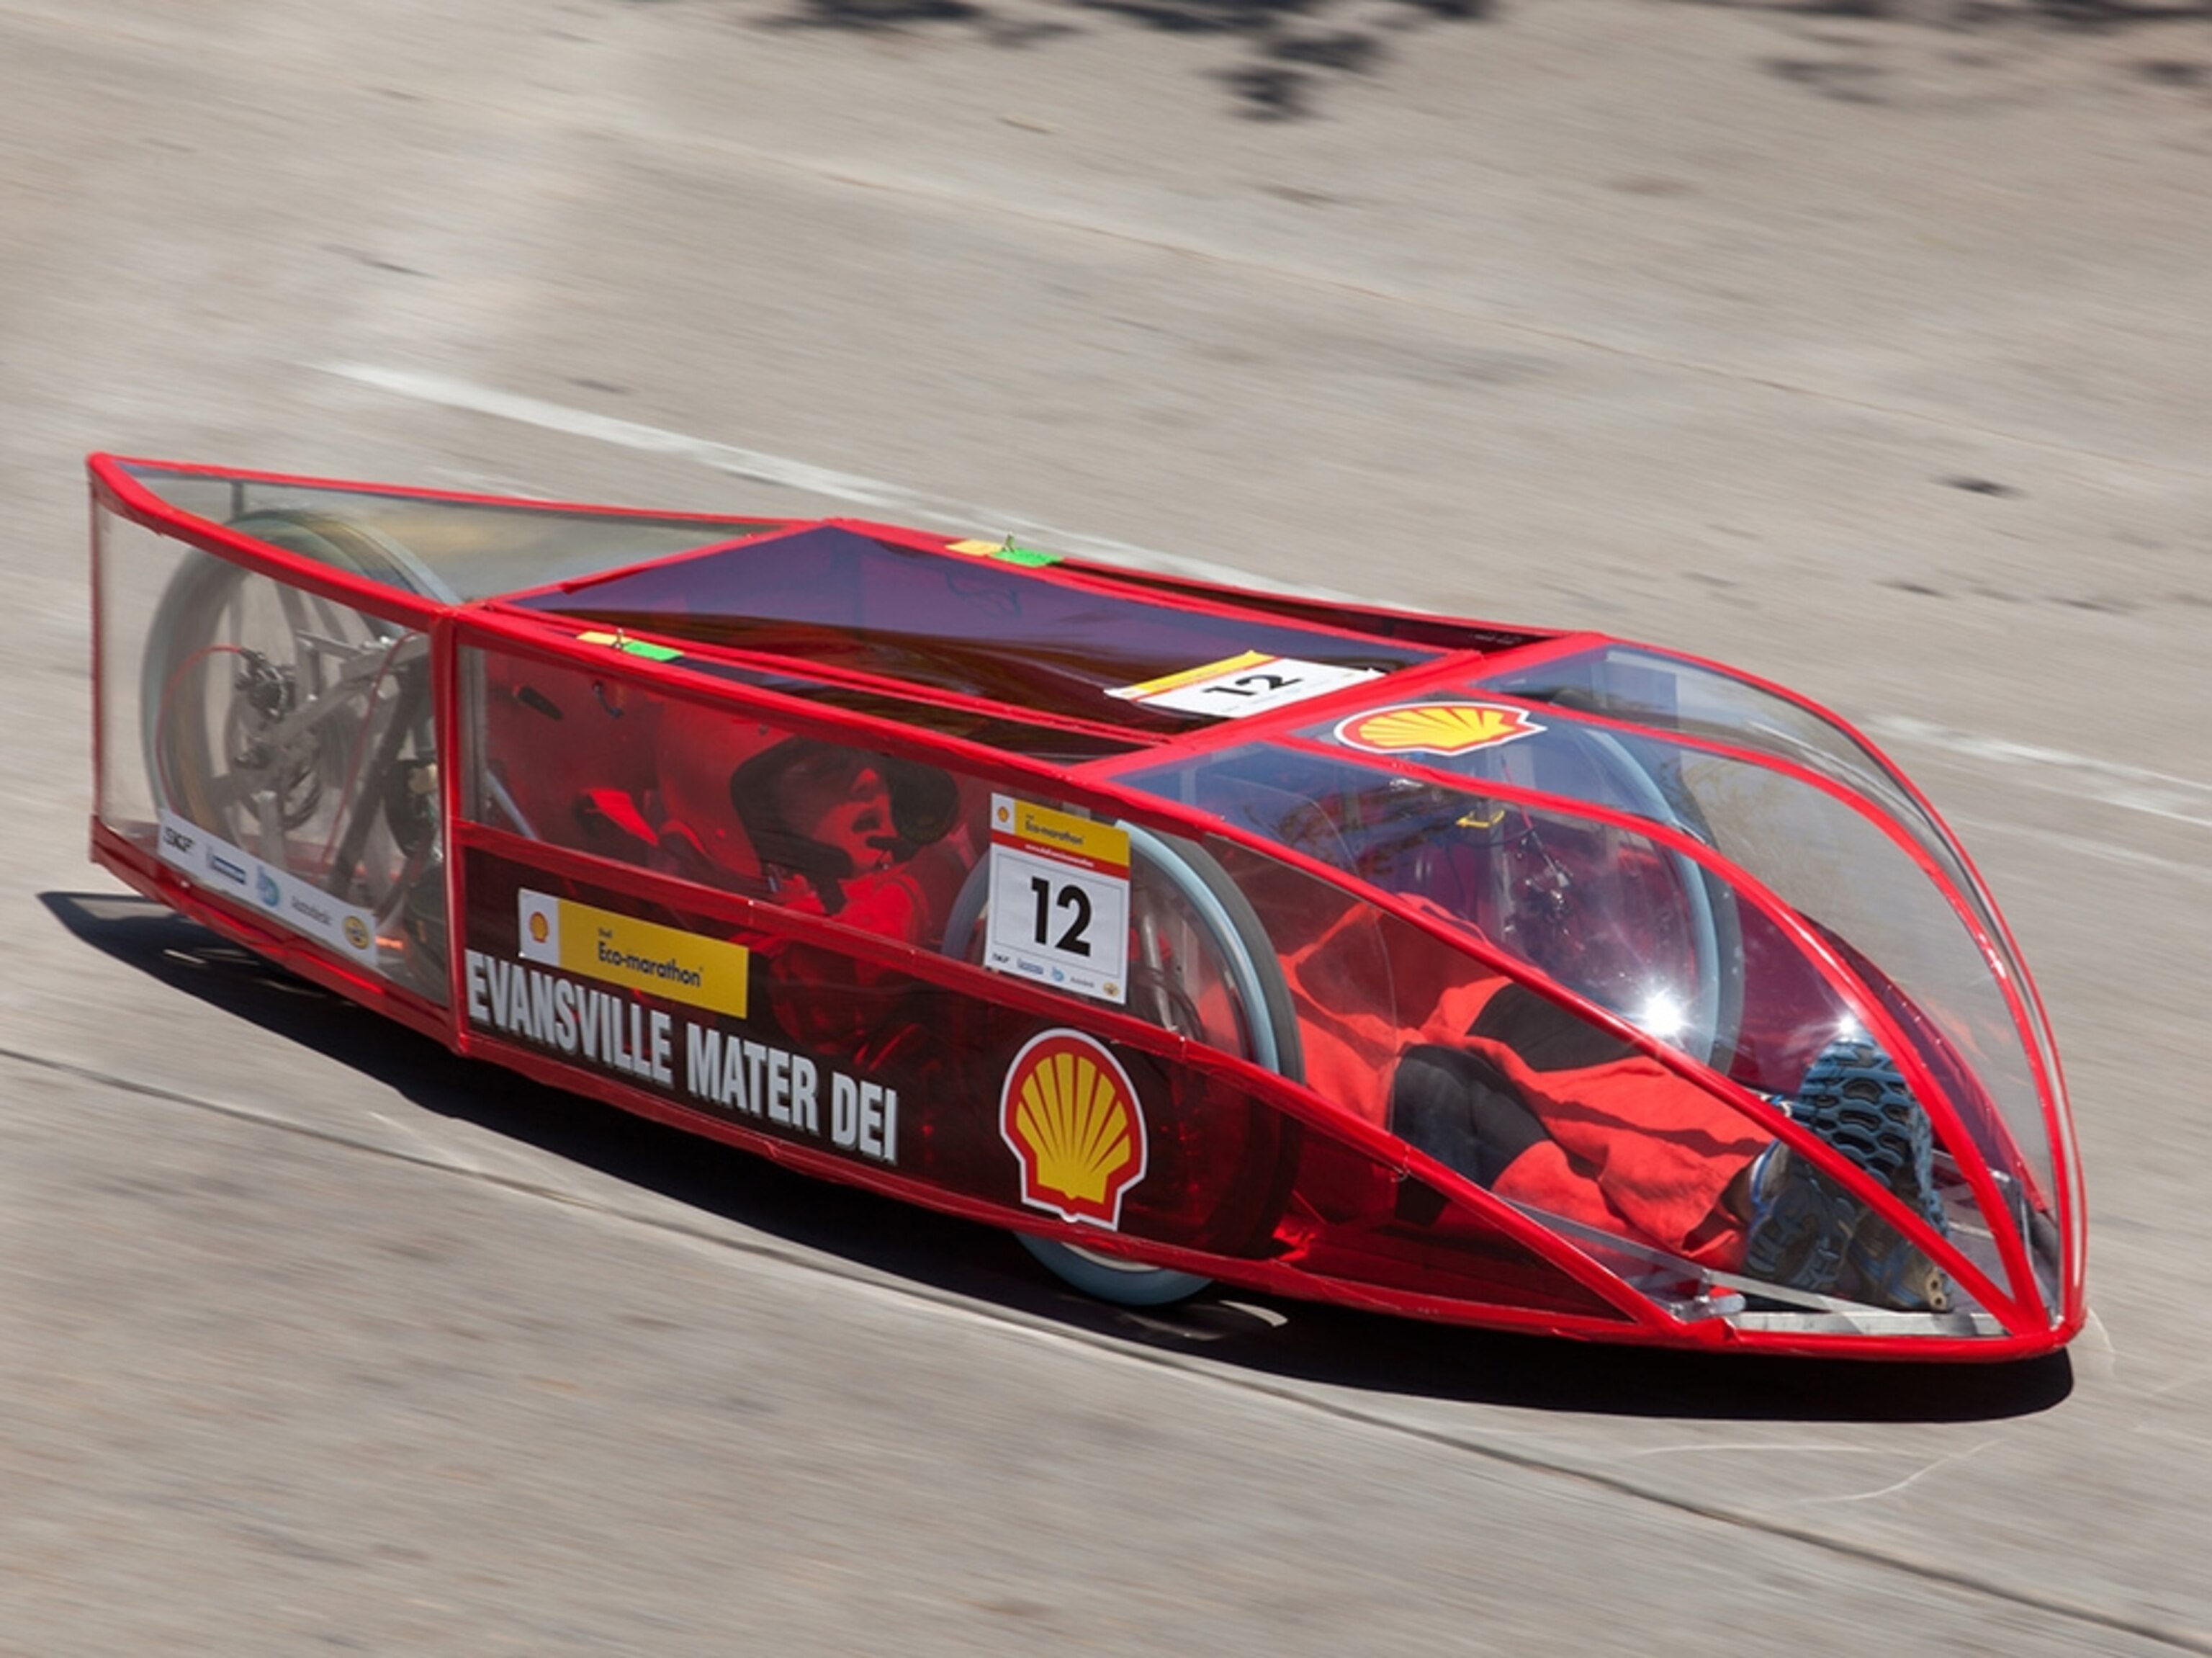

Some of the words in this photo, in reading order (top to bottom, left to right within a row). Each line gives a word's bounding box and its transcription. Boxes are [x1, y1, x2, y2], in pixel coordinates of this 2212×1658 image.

[1202, 674, 1303, 696] 12
[1030, 875, 1092, 958] 12
[465, 949, 673, 1088] EVANSVILLE
[687, 1022, 819, 1134] MATER
[832, 1071, 898, 1164] DEI
